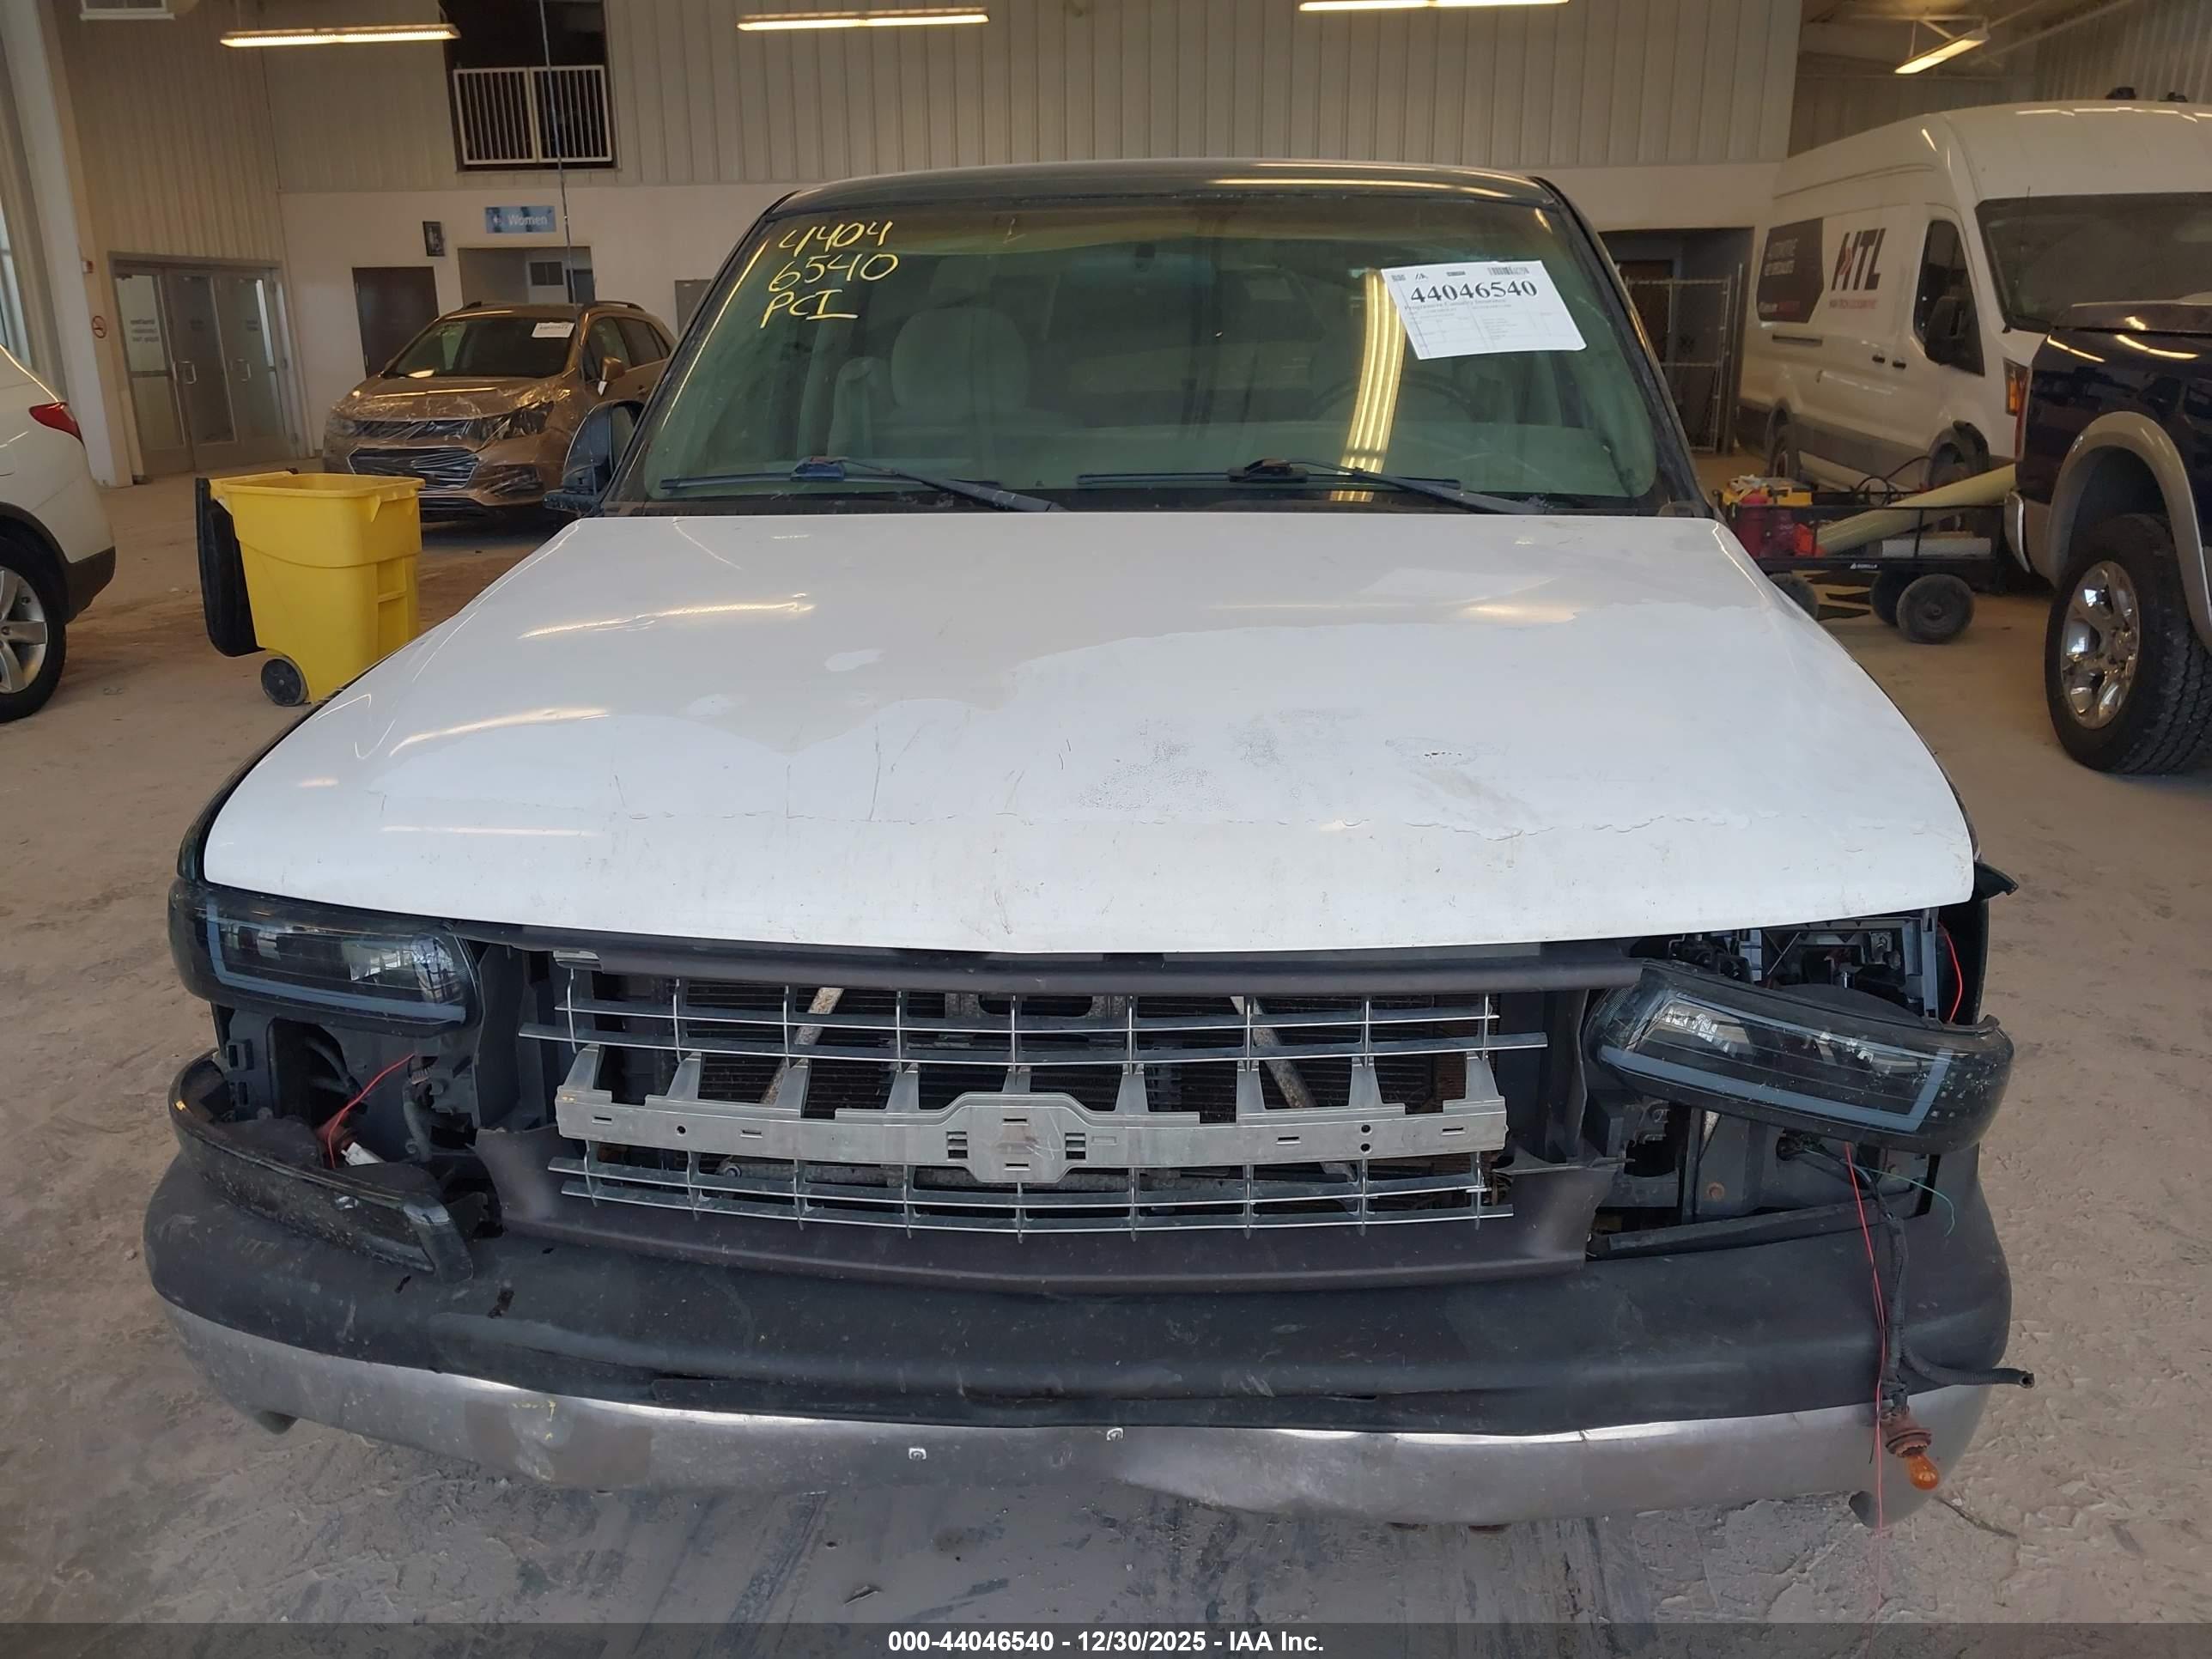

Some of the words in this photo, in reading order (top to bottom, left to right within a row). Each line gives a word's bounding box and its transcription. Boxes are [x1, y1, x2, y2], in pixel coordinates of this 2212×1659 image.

[507, 214, 548, 226] Women
[779, 220, 893, 258] 4404
[769, 253, 899, 292] 6540
[1831, 228, 1887, 290] HTL
[760, 289, 859, 329] PCI
[1411, 280, 1538, 303] 44046540
